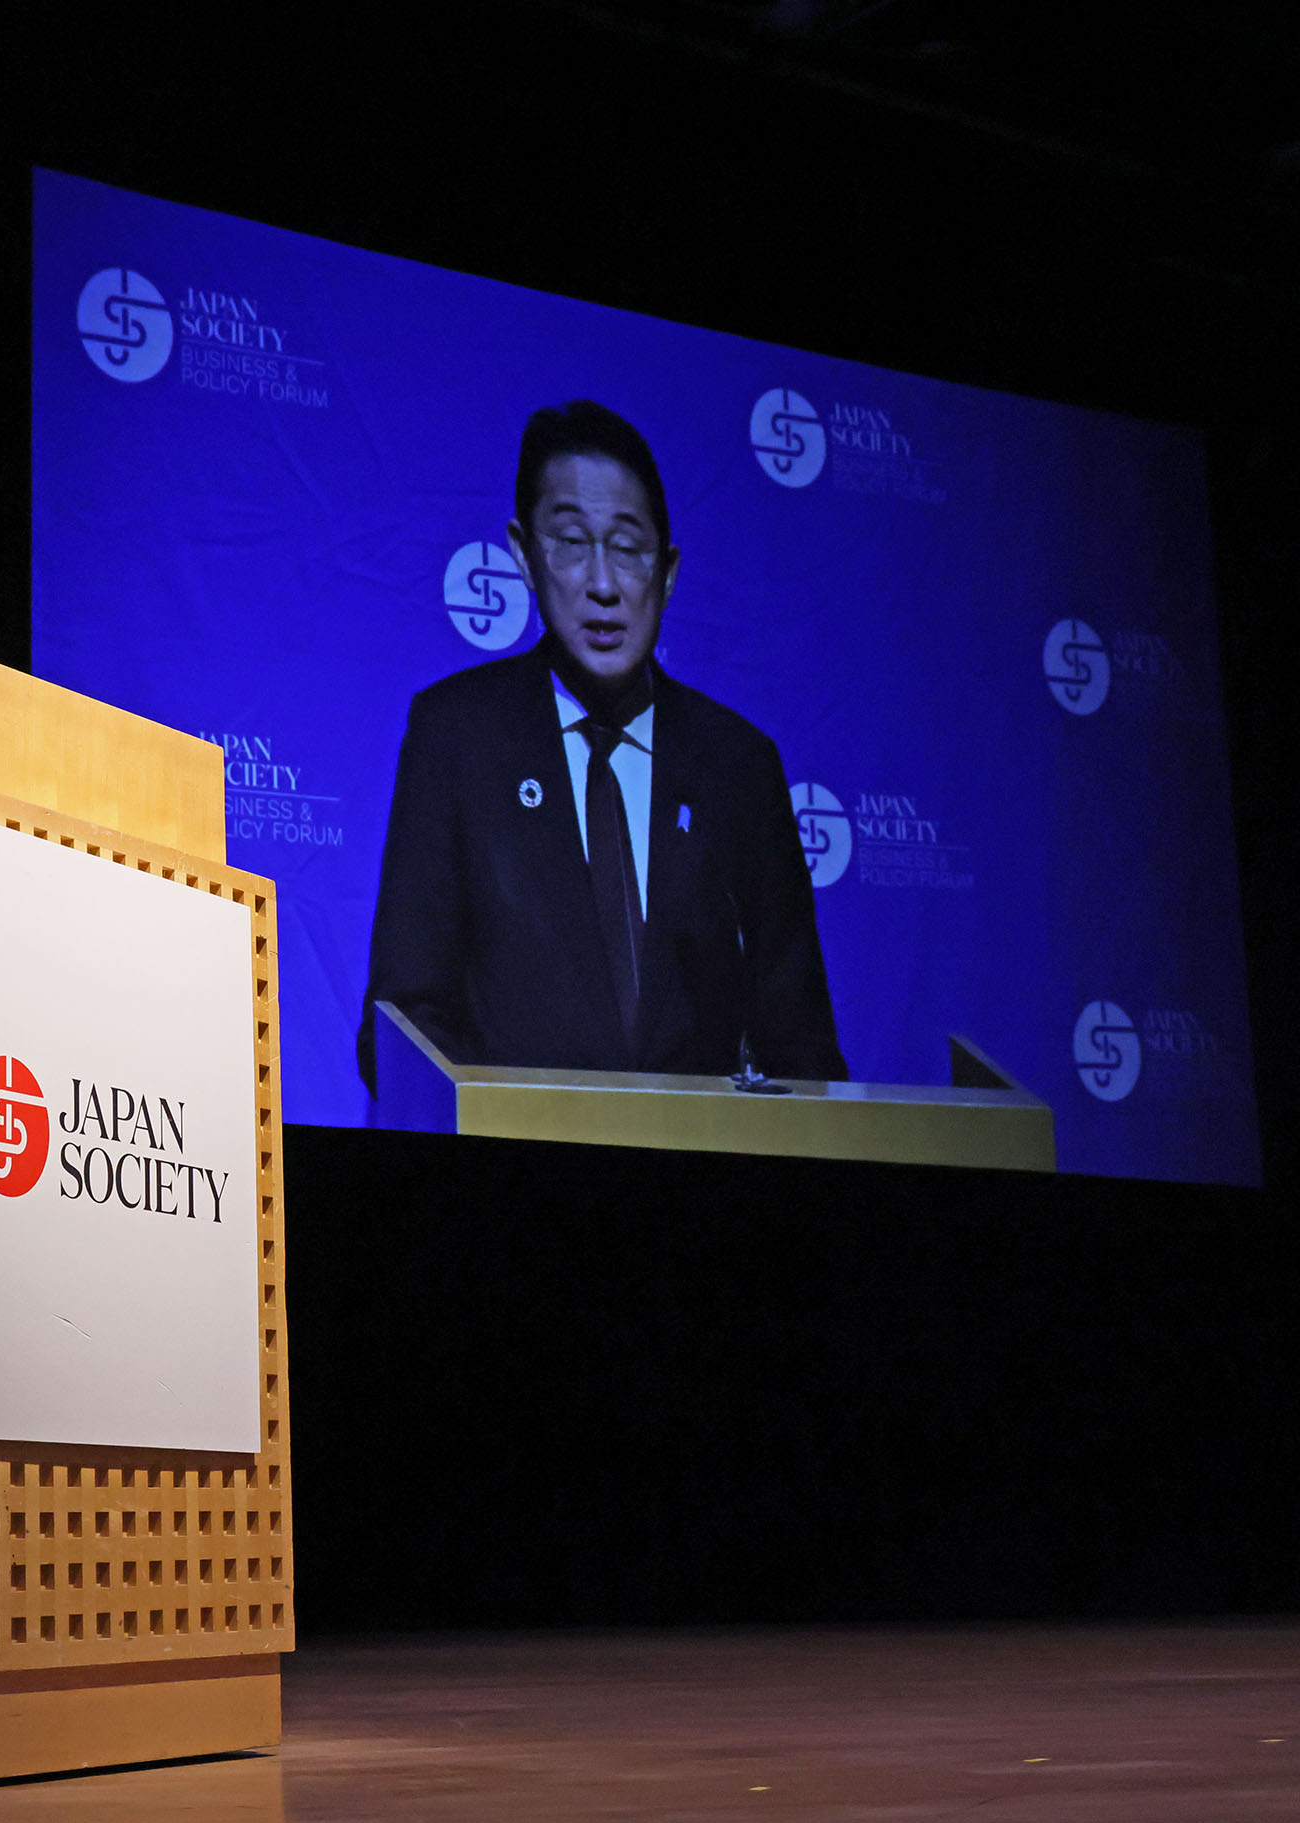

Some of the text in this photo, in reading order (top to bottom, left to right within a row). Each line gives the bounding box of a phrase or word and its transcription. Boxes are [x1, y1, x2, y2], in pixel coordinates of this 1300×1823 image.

[180, 287, 259, 321] JAPAN
[181, 314, 287, 352] SOCIETY
[181, 345, 298, 383] BUSINESS &
[181, 367, 329, 408] POLICY FORUM
[200, 731, 272, 761] PAN
[301, 802, 313, 822] &
[273, 822, 344, 847] FORUM
[59, 1078, 185, 1155] JAPAN
[60, 1142, 229, 1223] SOCIETY
